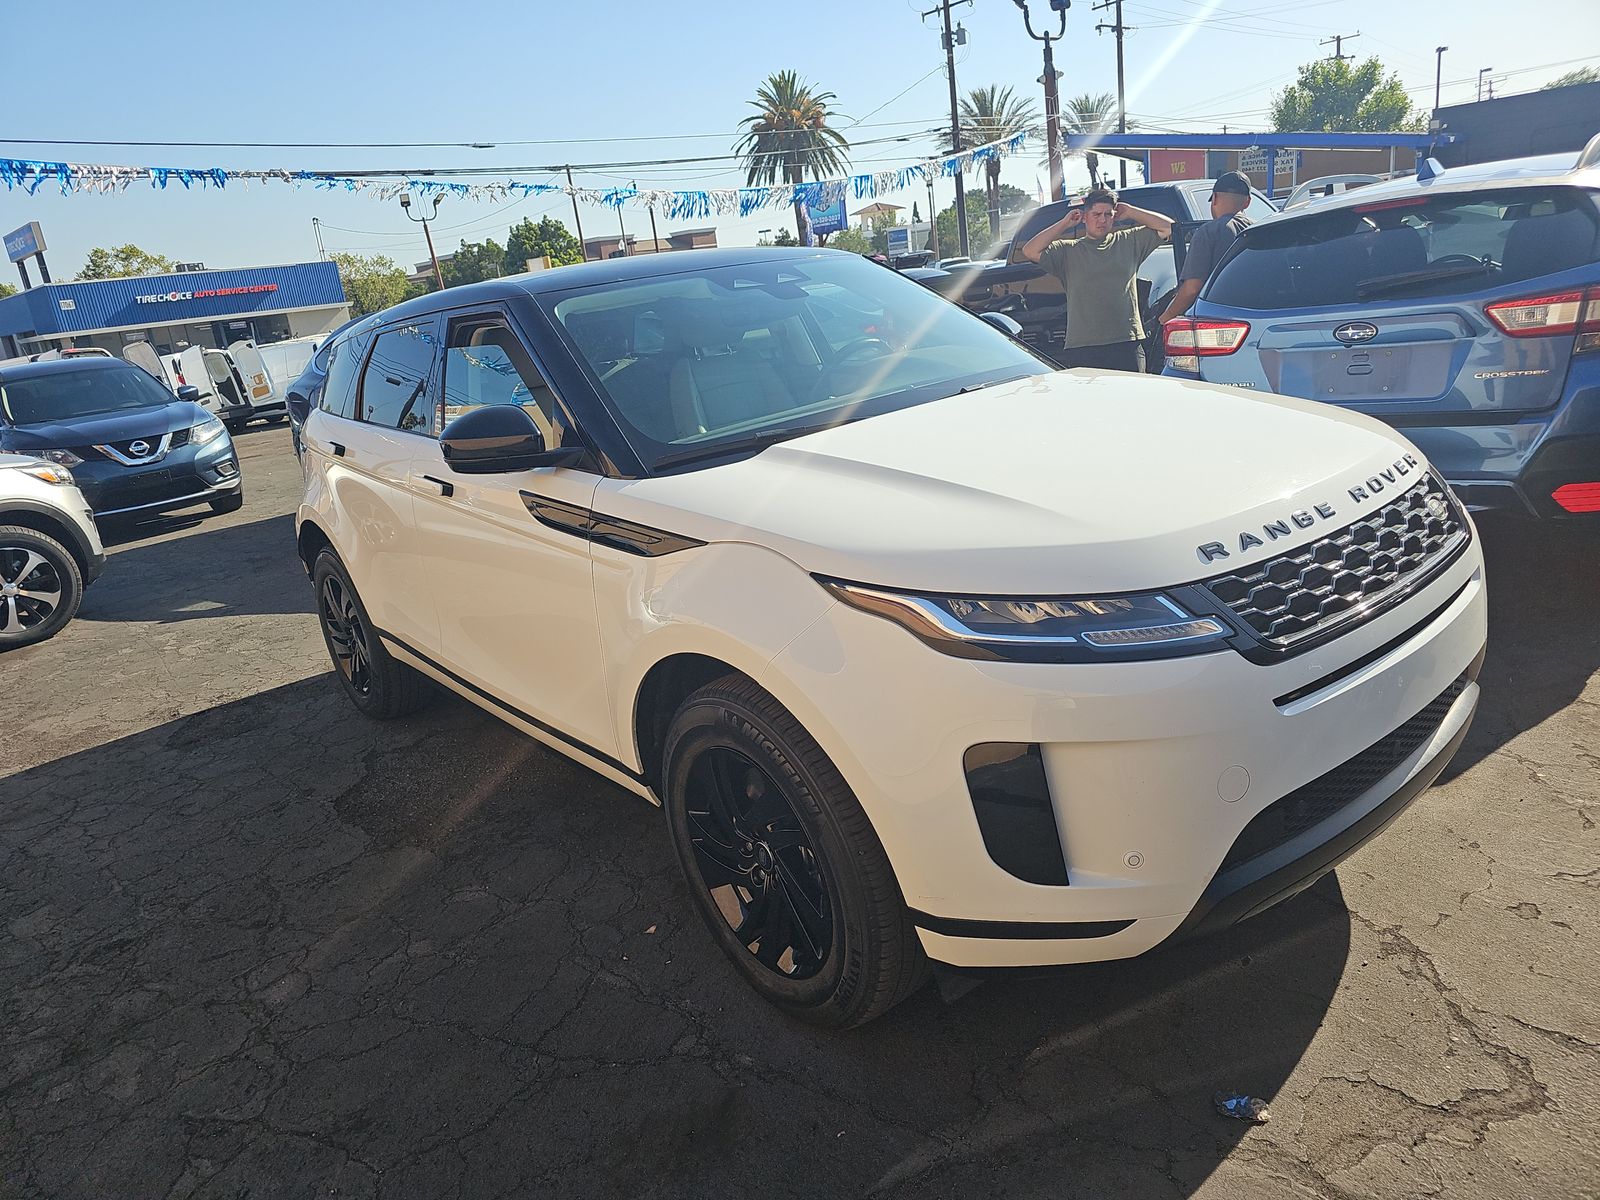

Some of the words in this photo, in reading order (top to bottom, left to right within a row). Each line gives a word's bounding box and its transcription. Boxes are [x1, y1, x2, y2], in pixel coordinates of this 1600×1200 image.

[1170, 161, 1185, 175] WE
[194, 289, 216, 299] AUTO
[216, 286, 249, 297] SERVICE
[249, 283, 279, 294] CENTER
[1196, 501, 1337, 563] RANGE
[1347, 452, 1419, 504] ROVER
[742, 721, 822, 817] MICHELIN
